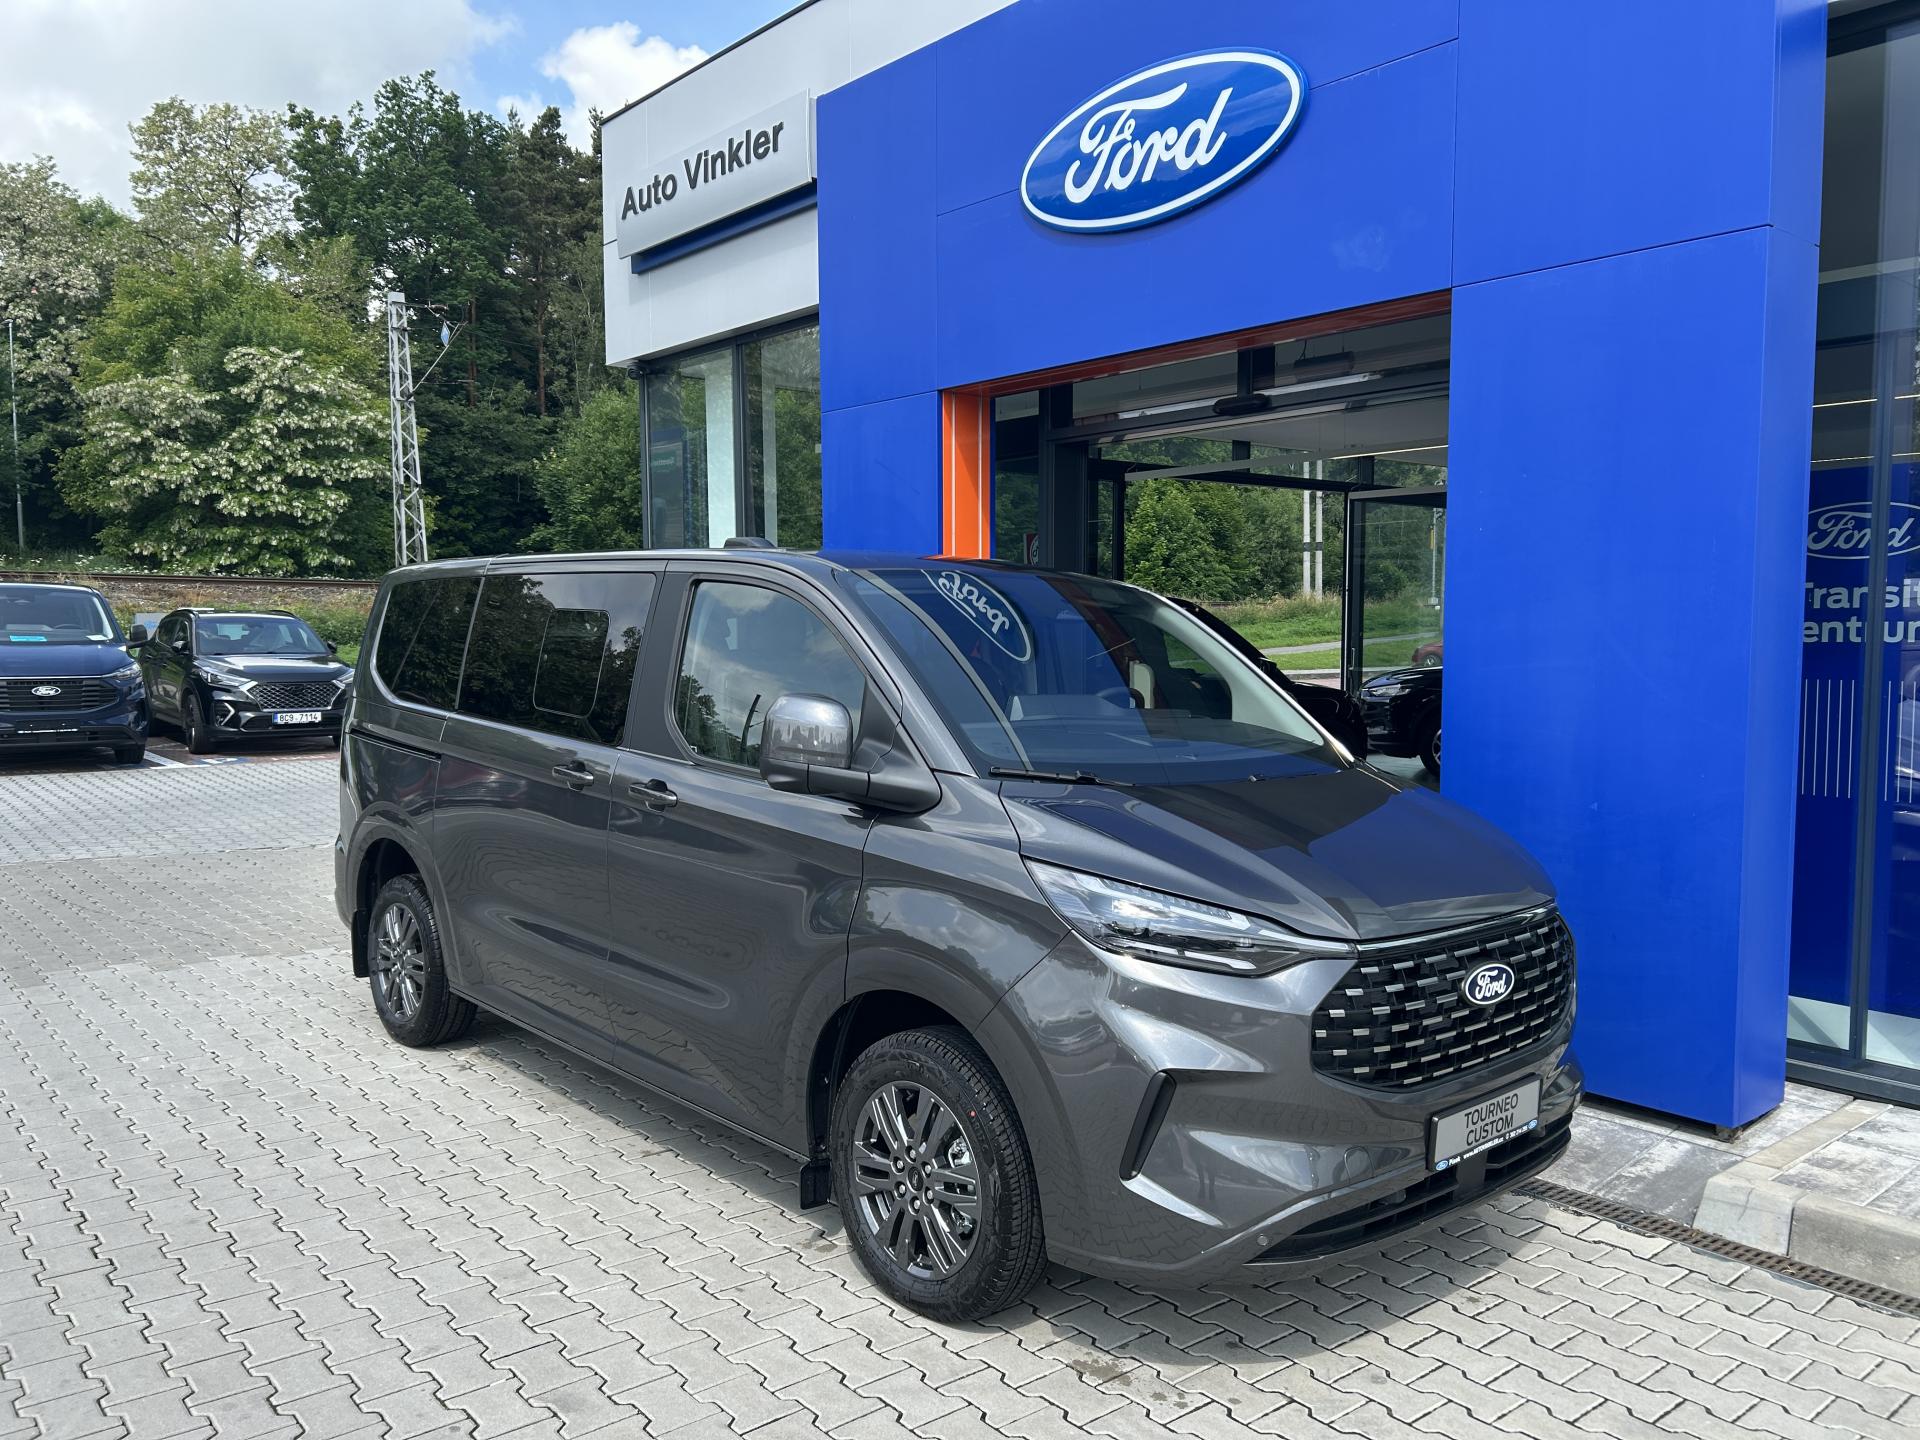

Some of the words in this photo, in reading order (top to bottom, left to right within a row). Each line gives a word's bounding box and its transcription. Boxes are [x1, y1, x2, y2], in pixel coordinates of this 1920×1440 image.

[1064, 82, 1233, 203] Ford
[621, 186, 677, 219] Auto
[684, 121, 784, 189] Vinkler
[1804, 616, 1920, 643] entu
[1475, 969, 1506, 1000] Ford
[1464, 1093, 1519, 1128] TOURNEO
[1466, 1112, 1514, 1146] CUSTOM
